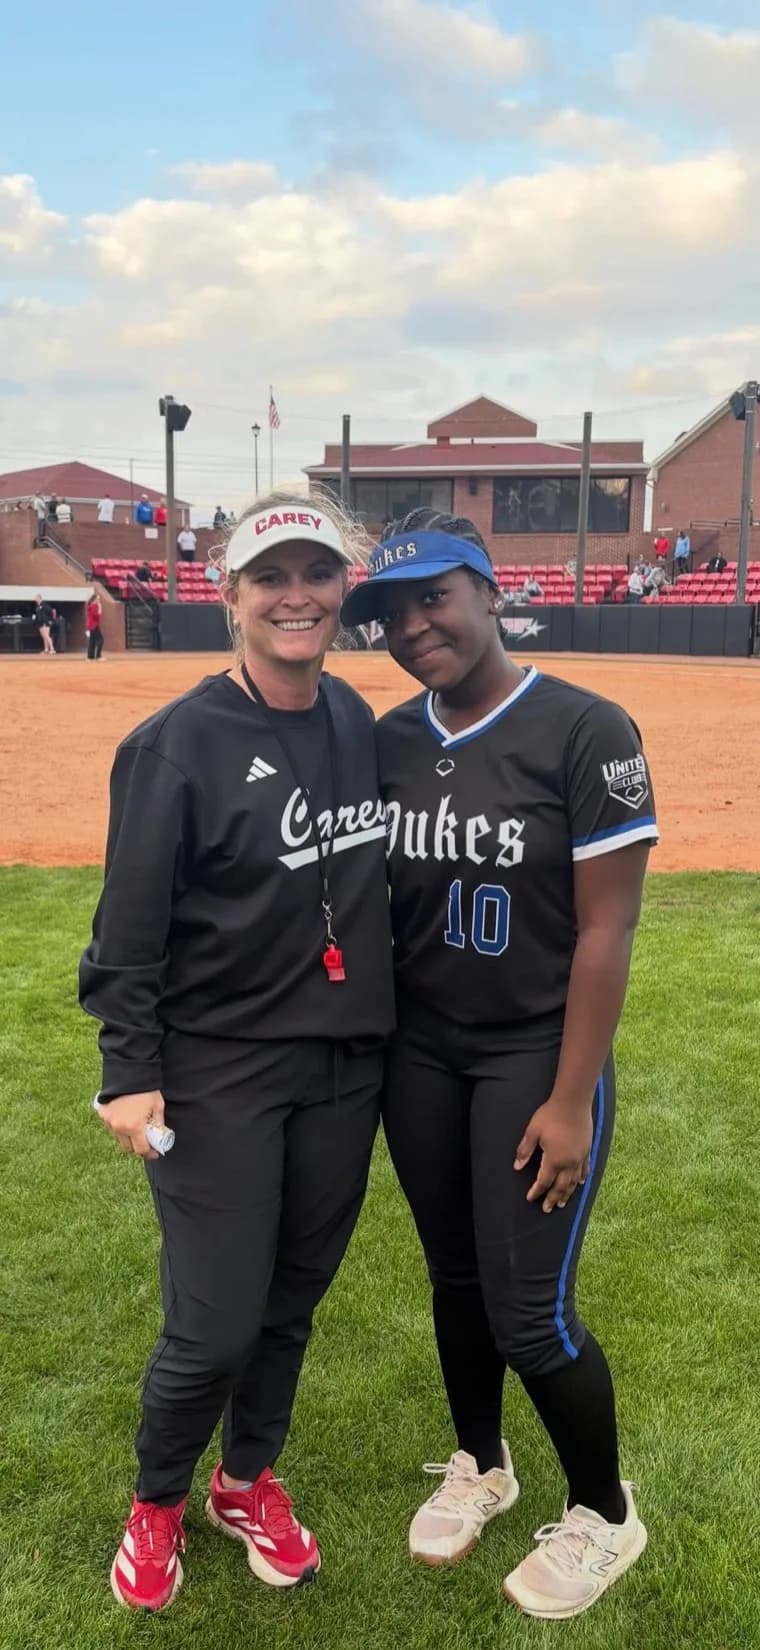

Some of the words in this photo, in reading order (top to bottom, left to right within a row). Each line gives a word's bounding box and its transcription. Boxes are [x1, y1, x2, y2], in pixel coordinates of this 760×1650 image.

[254, 512, 322, 536] CAREY
[368, 542, 417, 577] ukes
[444, 878, 511, 956] 10
